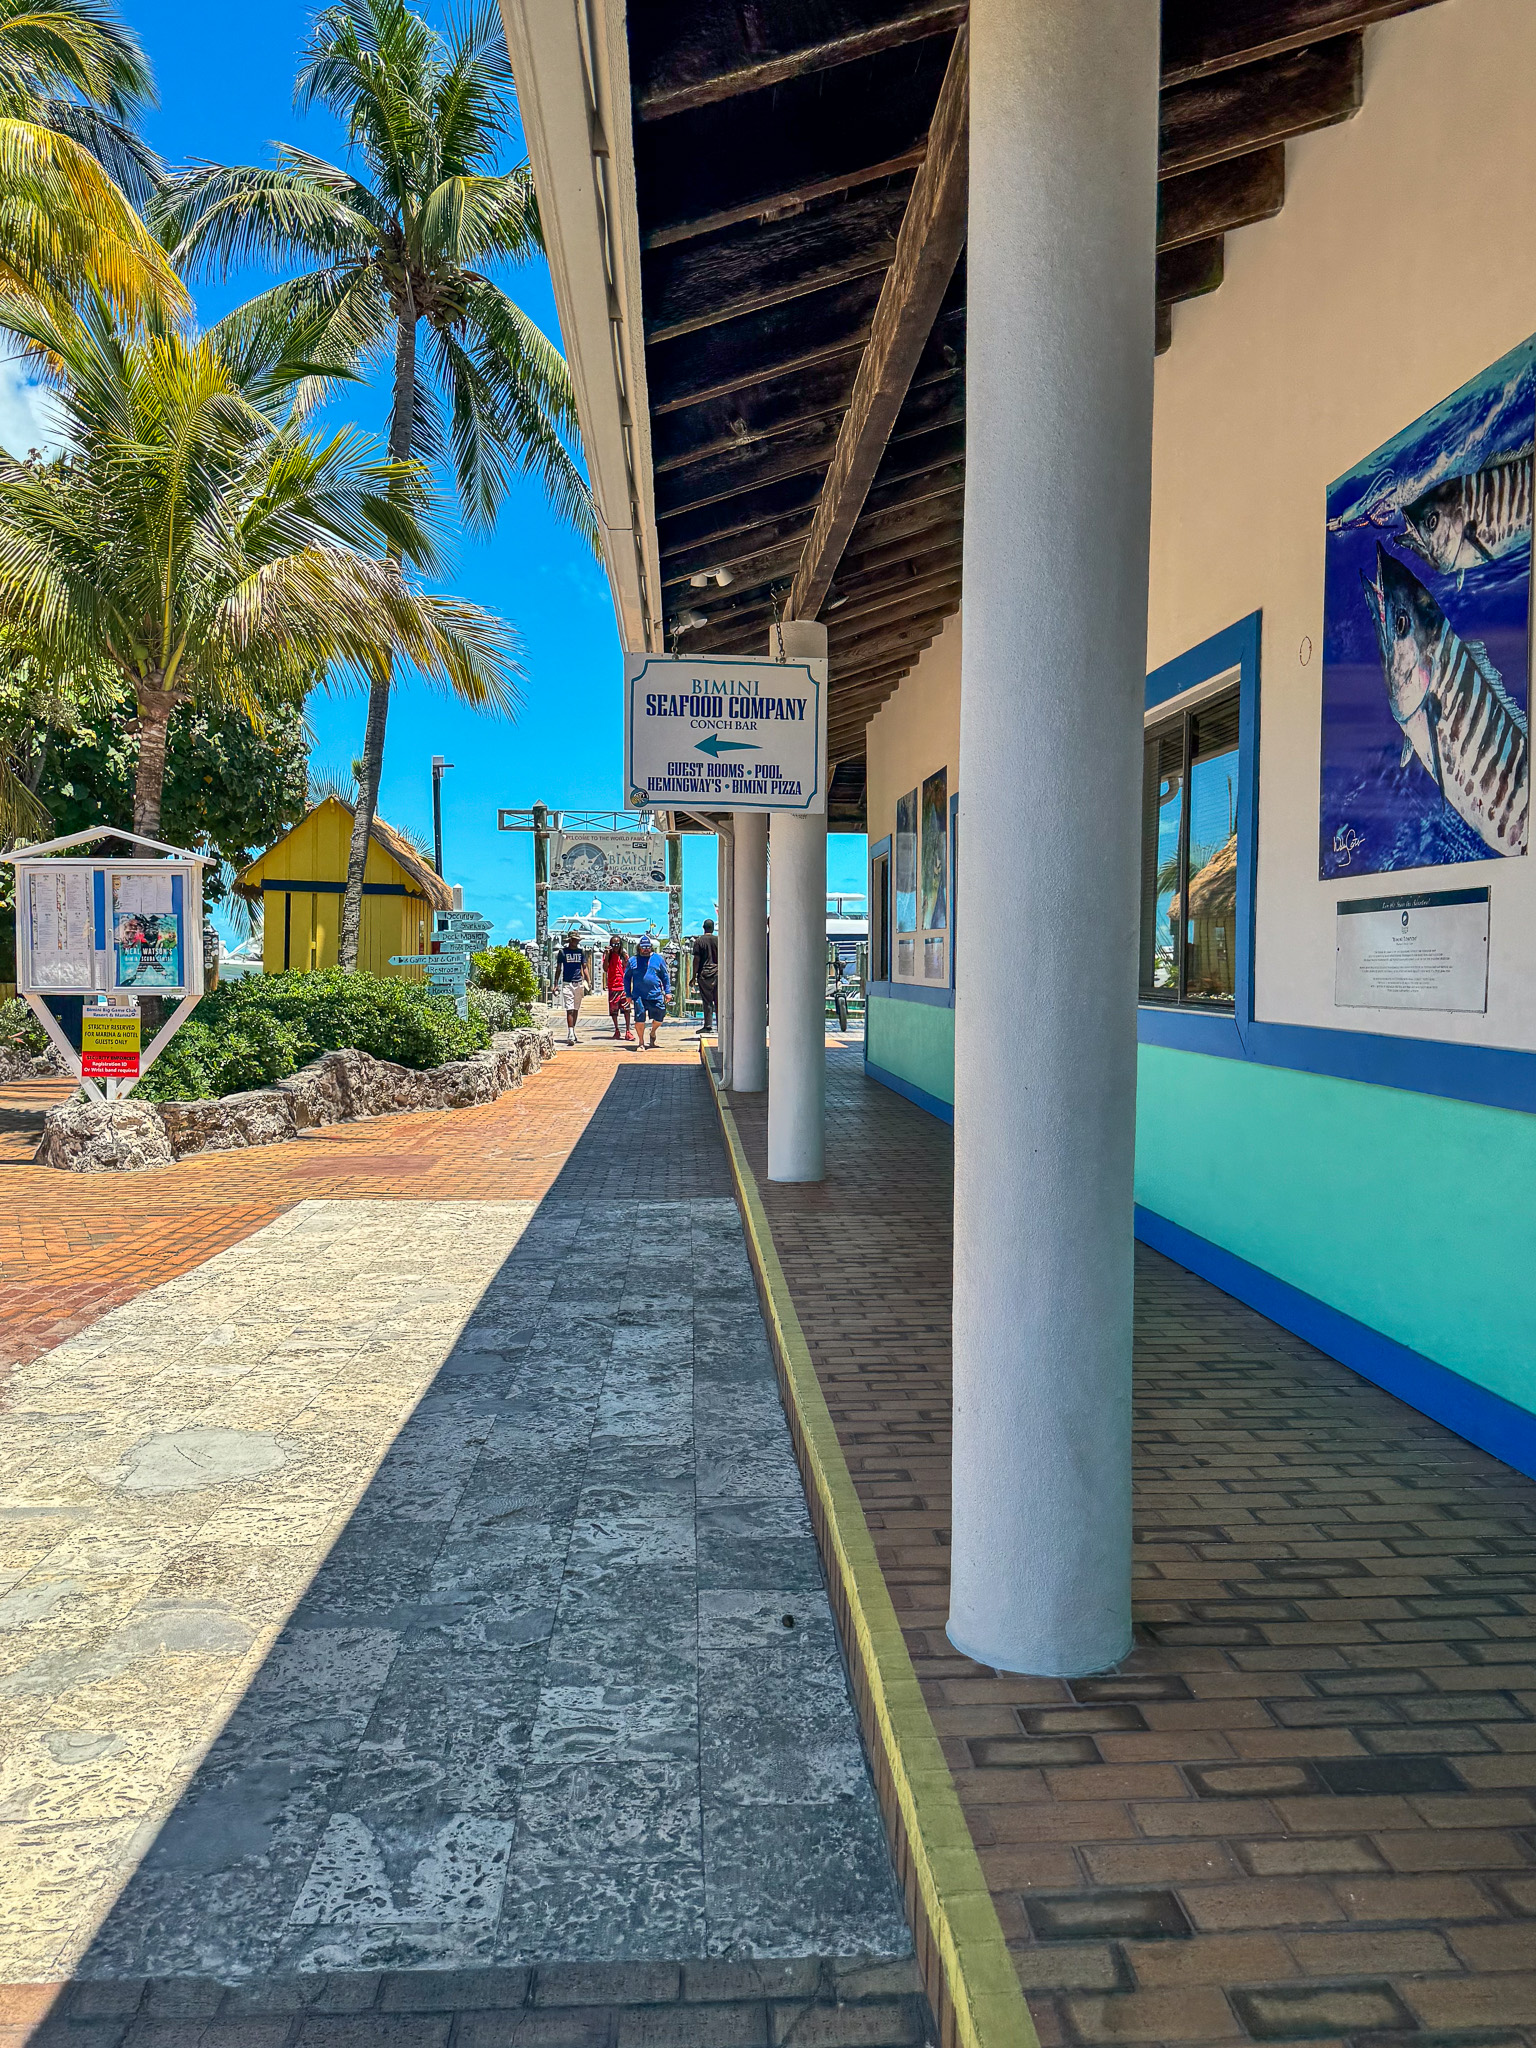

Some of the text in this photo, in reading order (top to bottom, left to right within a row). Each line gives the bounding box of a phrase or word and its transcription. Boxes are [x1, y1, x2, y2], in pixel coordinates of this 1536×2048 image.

[691, 679, 760, 696] BIMINI
[646, 694, 807, 720] SEAFOOD COMPANY
[690, 719, 758, 731] CONCH BAR
[667, 761, 783, 779] GUEST ROOMS POOL
[647, 776, 802, 795] HEMINGWAY'S BIMINI PIZZA
[609, 855, 653, 865] BIMINI
[566, 953, 582, 961] ELITE
